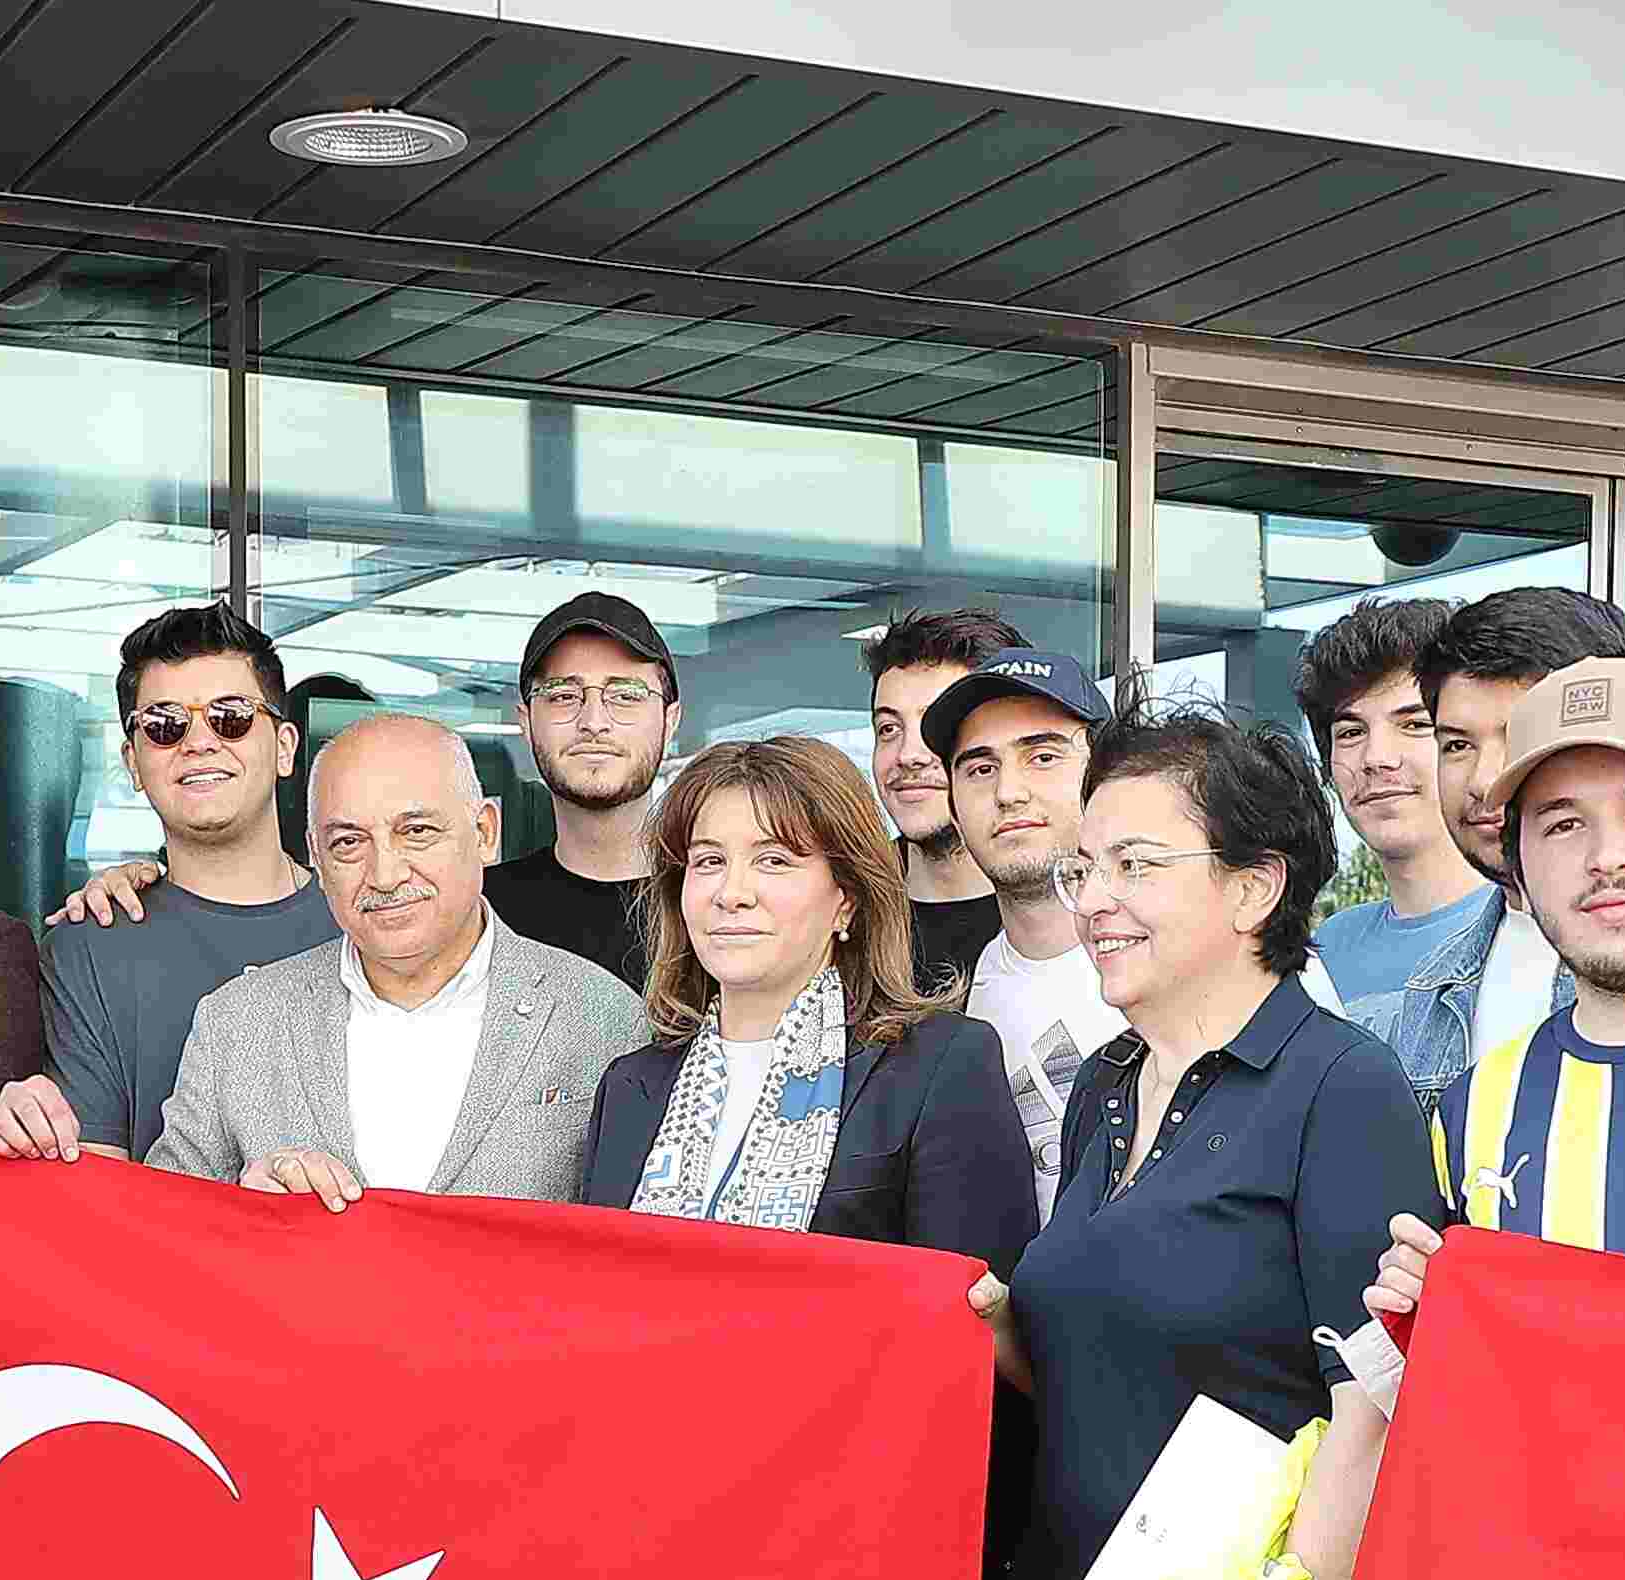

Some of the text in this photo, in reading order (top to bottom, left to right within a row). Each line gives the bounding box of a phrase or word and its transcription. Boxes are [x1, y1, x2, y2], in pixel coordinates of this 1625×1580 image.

[988, 661, 1053, 678] TAIN
[1568, 686, 1604, 700] NYC
[1567, 700, 1604, 714] CRW
